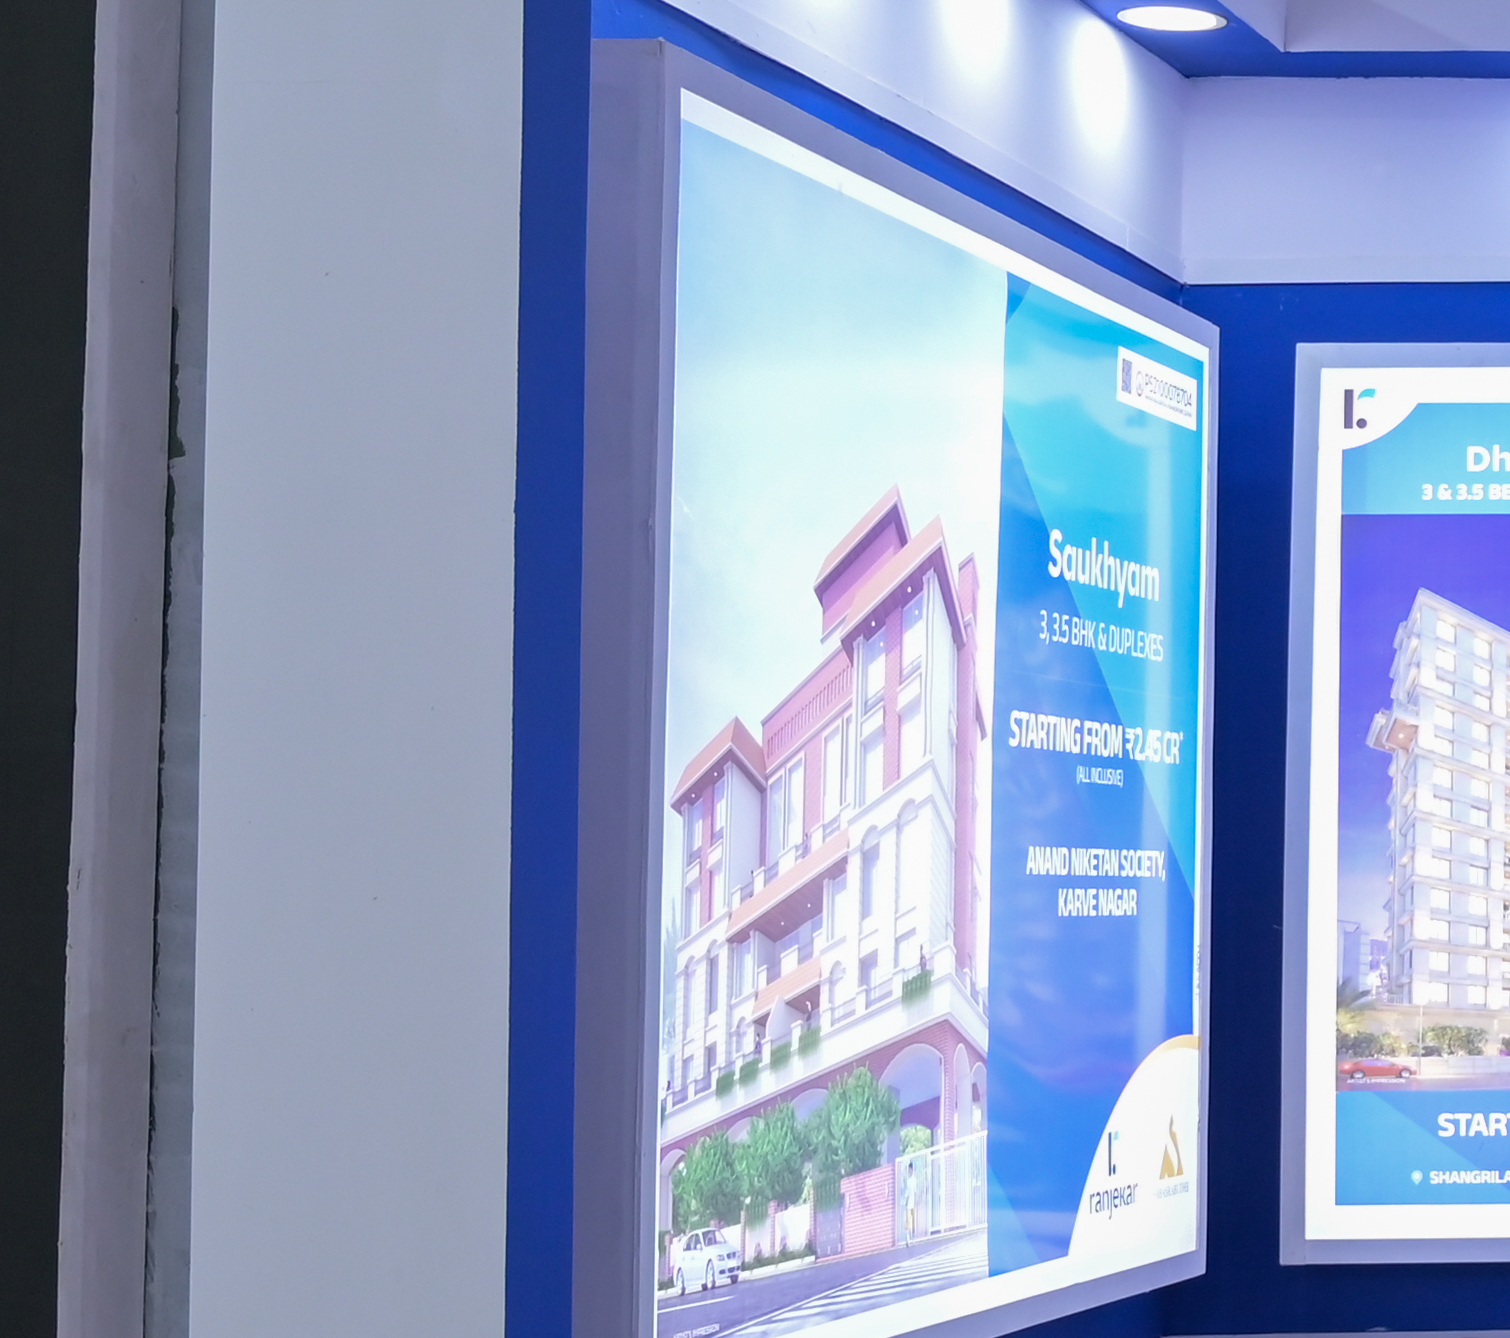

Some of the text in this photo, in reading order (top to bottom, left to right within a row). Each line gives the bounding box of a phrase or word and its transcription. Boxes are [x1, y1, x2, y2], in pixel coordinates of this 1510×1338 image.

[1421, 483, 1433, 501] 3
[1437, 483, 1453, 501] &
[1456, 483, 1484, 501] 3.5
[1047, 528, 1160, 609] Saukhyam
[1039, 609, 1165, 662] 3, 3.5 BHK & DUPLEXES
[1008, 710, 1081, 755] STARTING
[1083, 720, 1123, 759] FROM
[1026, 845, 1166, 883] ANAND NIKETAN SOCIETY,
[1058, 888, 1138, 917] KARVE NAGAR
[1089, 1183, 1138, 1220] ranjekar
